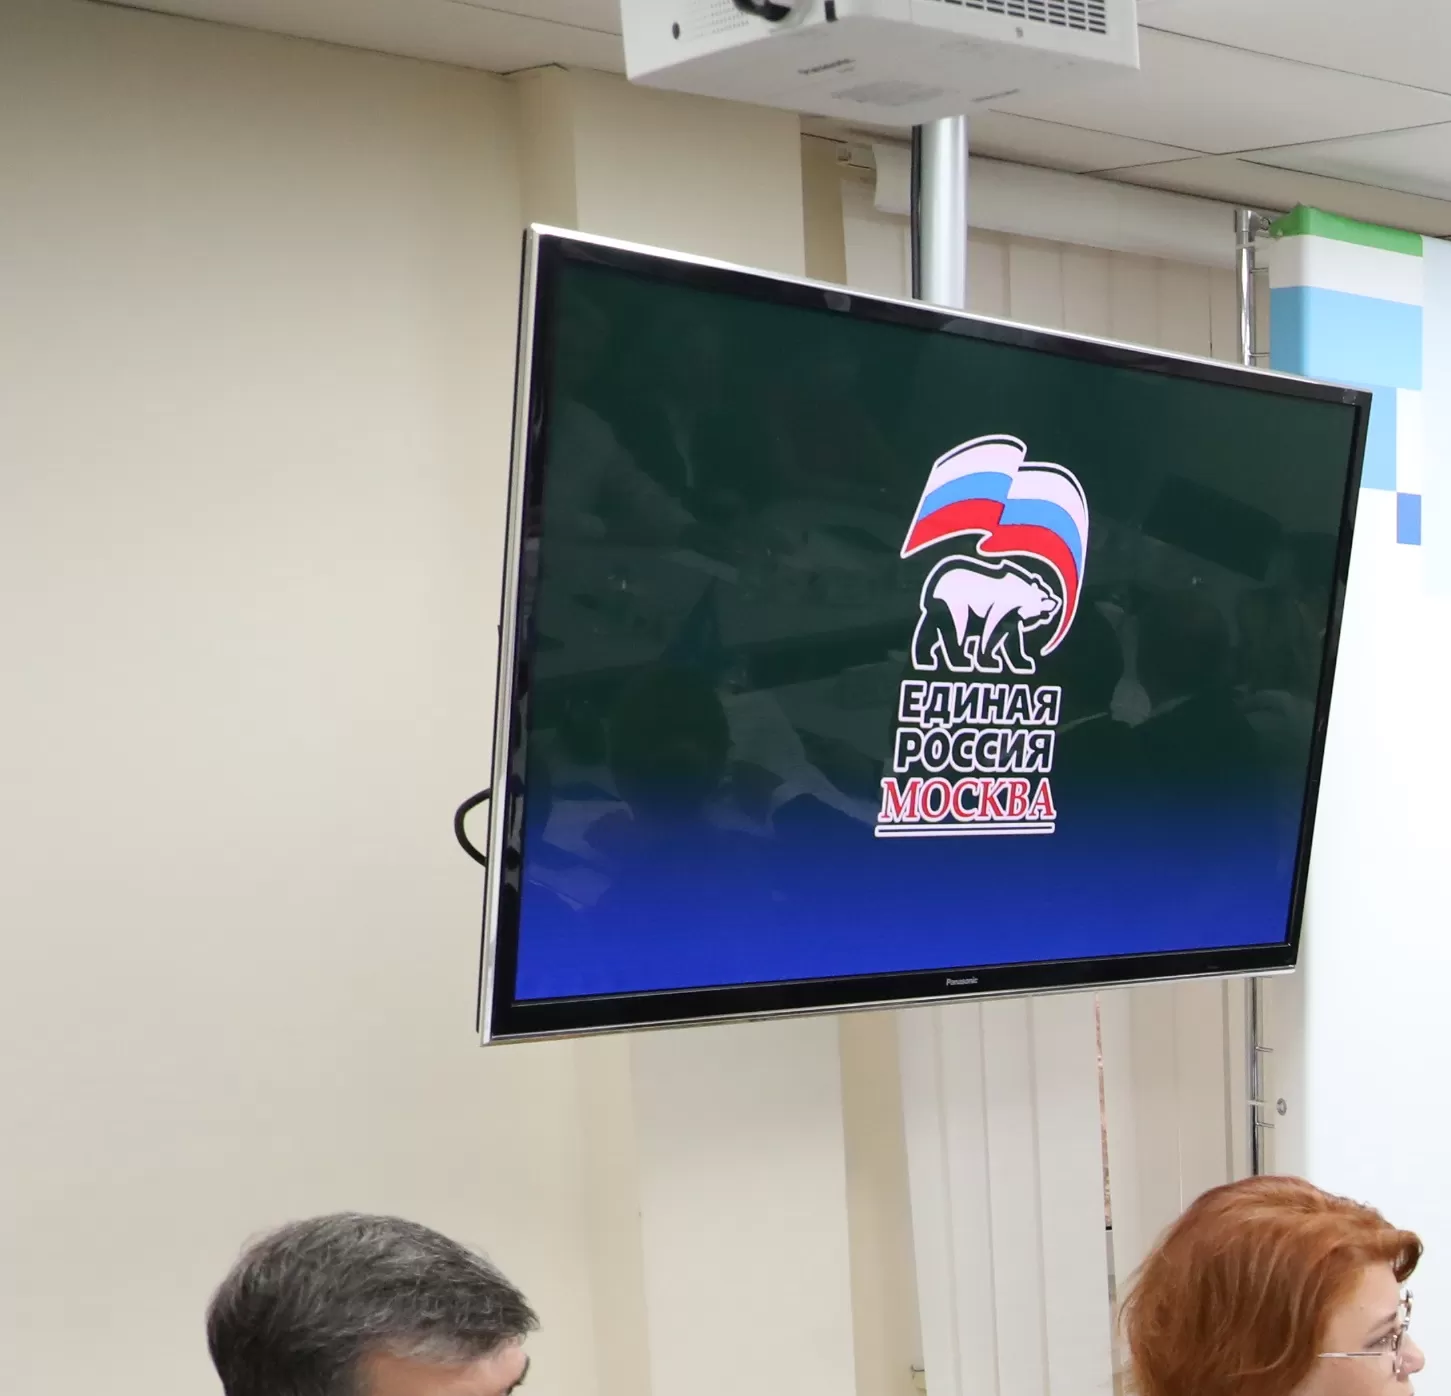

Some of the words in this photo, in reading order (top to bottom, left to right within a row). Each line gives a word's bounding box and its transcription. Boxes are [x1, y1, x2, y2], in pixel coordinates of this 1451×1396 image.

[898, 681, 1062, 725] ЕДИНАЯ
[893, 727, 1055, 772] РОССИЯ
[878, 778, 1057, 822] МОСКВА
